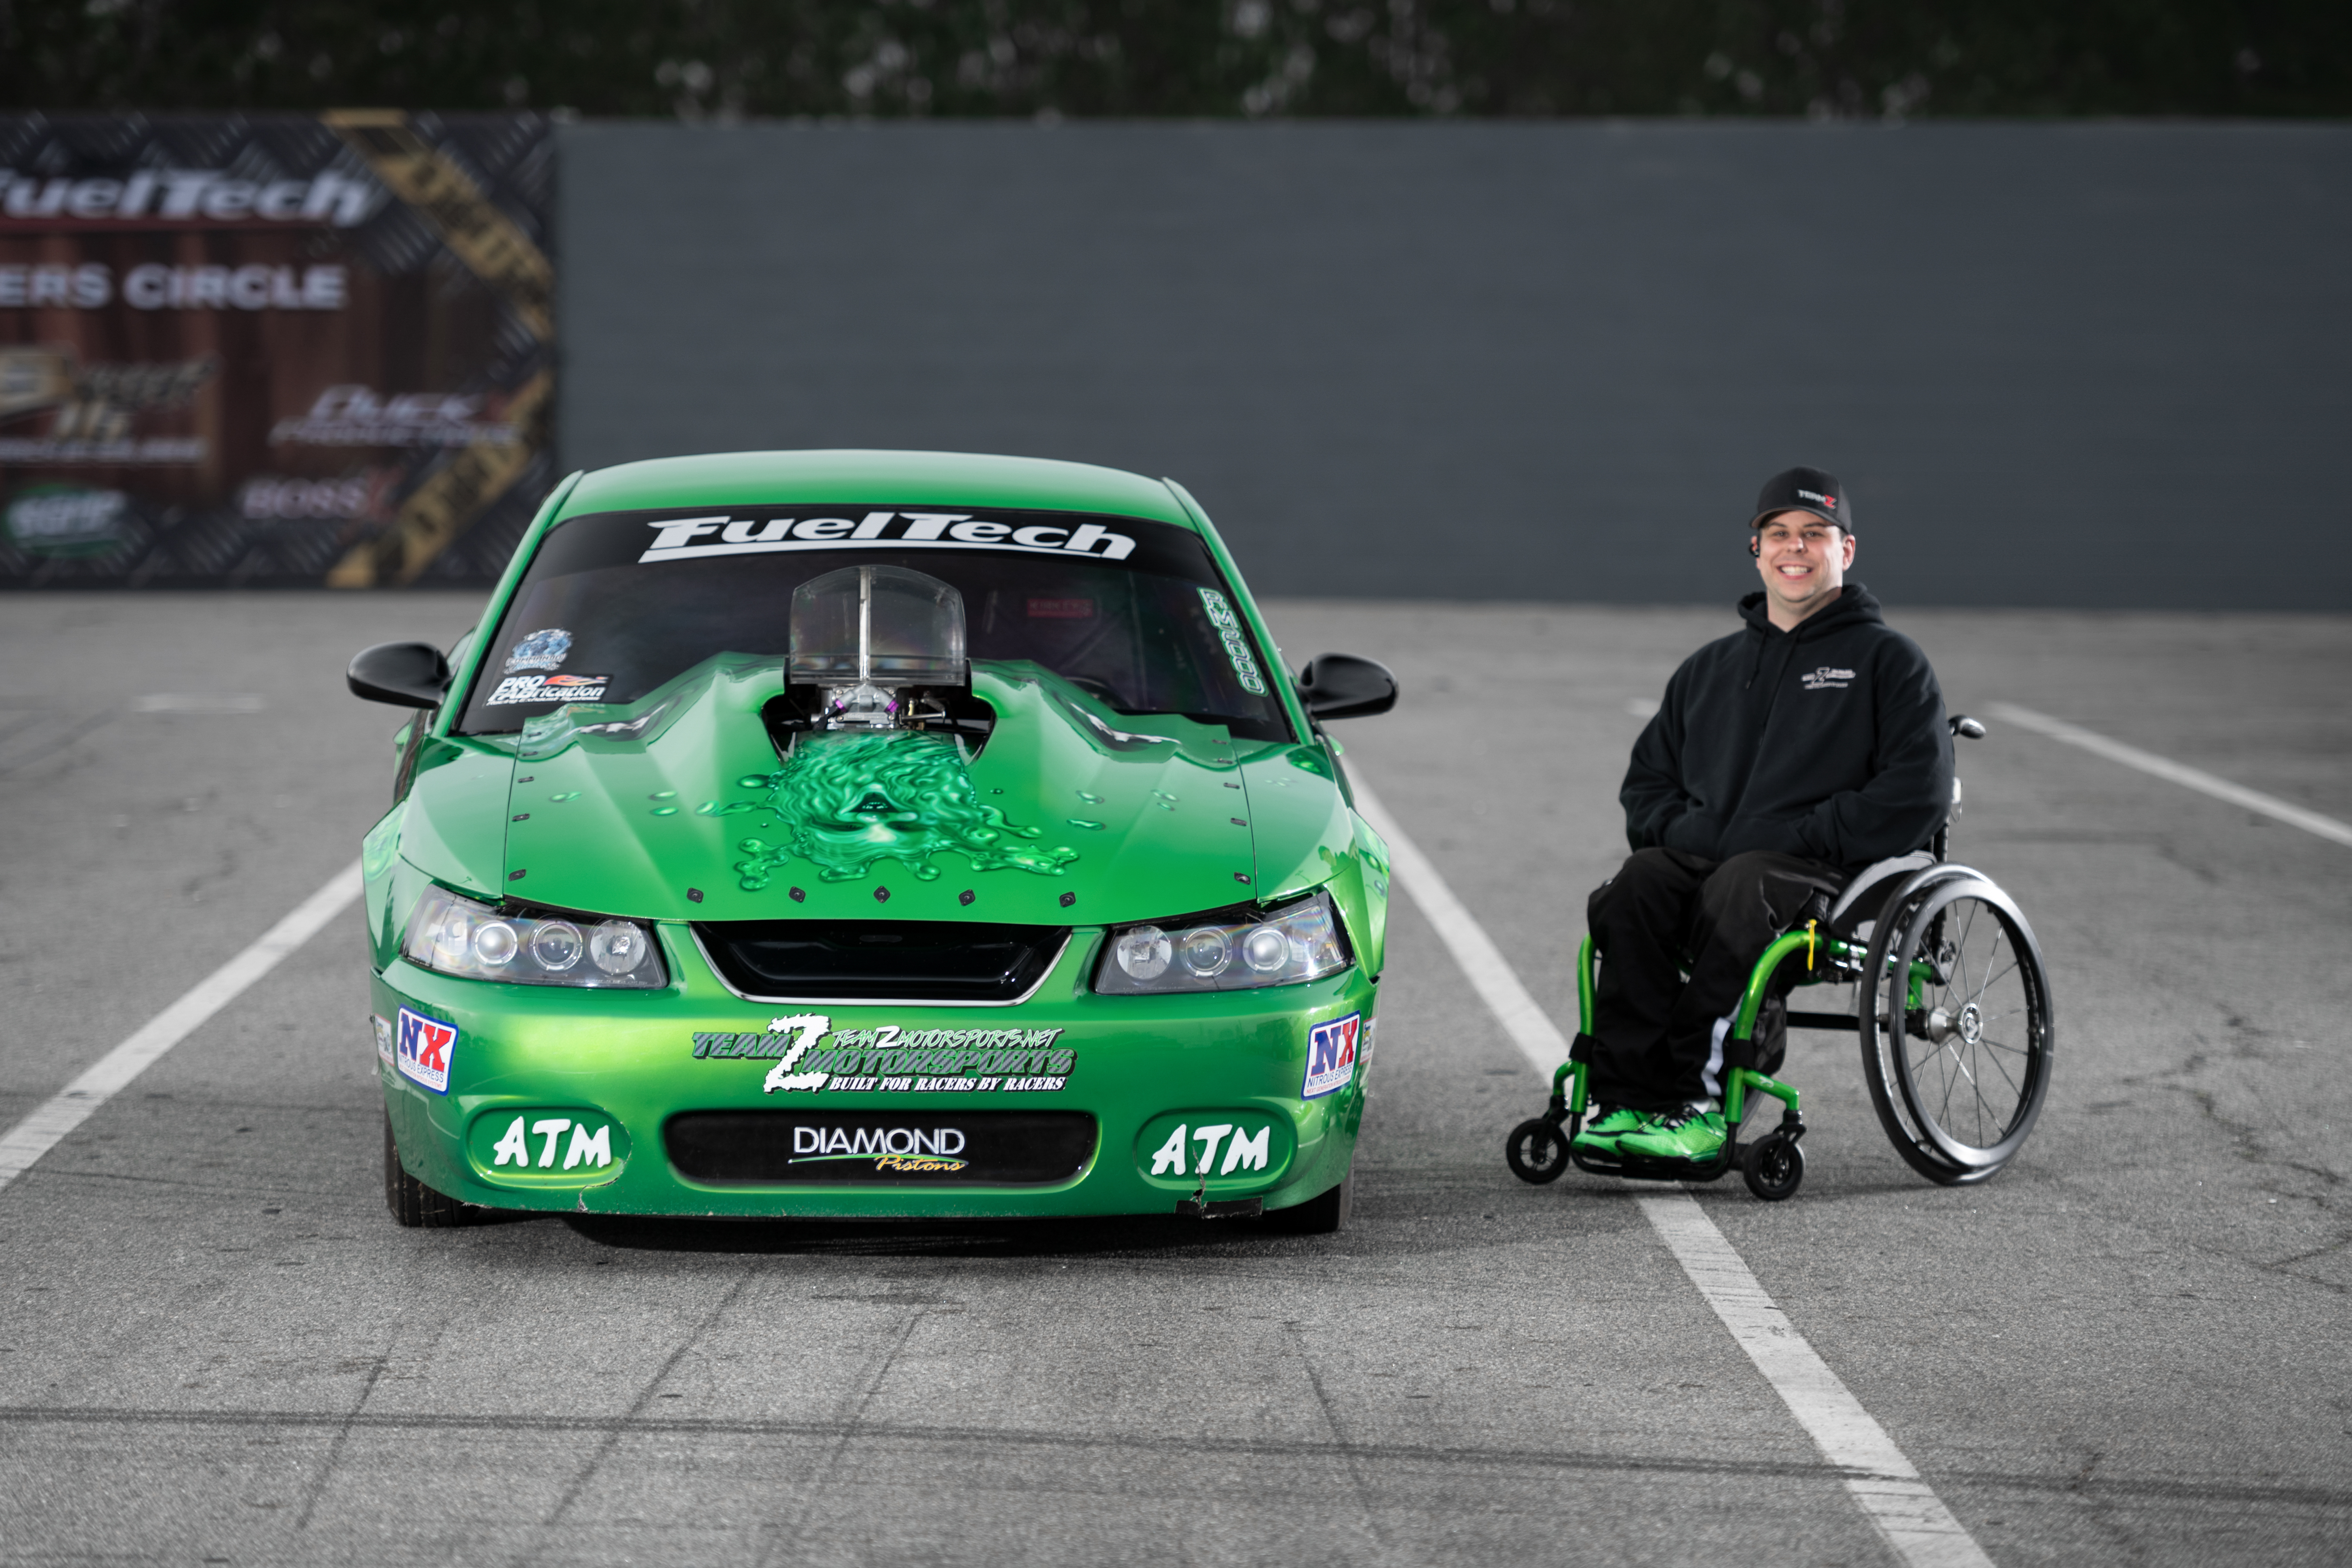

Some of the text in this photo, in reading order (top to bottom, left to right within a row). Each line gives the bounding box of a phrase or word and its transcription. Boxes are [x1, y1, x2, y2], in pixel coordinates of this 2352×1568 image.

[0, 169, 372, 227] uelTech
[123, 263, 348, 311] CIRCLE
[647, 512, 1137, 560] FuelTech
[488, 685, 606, 702] FABrication
[496, 675, 546, 691] PRO
[399, 1012, 452, 1073] NX
[692, 1012, 1075, 1093] TEAM Z MOTORSPORTS
[1311, 1018, 1358, 1077] NX
[399, 1053, 444, 1083] NITROUS EXPRESS
[828, 1077, 1066, 1091] BUILT FOR RACERS BY RACERS
[1307, 1062, 1353, 1088] NITROUS EXPRESS
[493, 1116, 611, 1170] ATM
[794, 1127, 965, 1154] DIAMOND
[874, 1154, 965, 1171] Pistons
[1151, 1124, 1270, 1176] ATM
